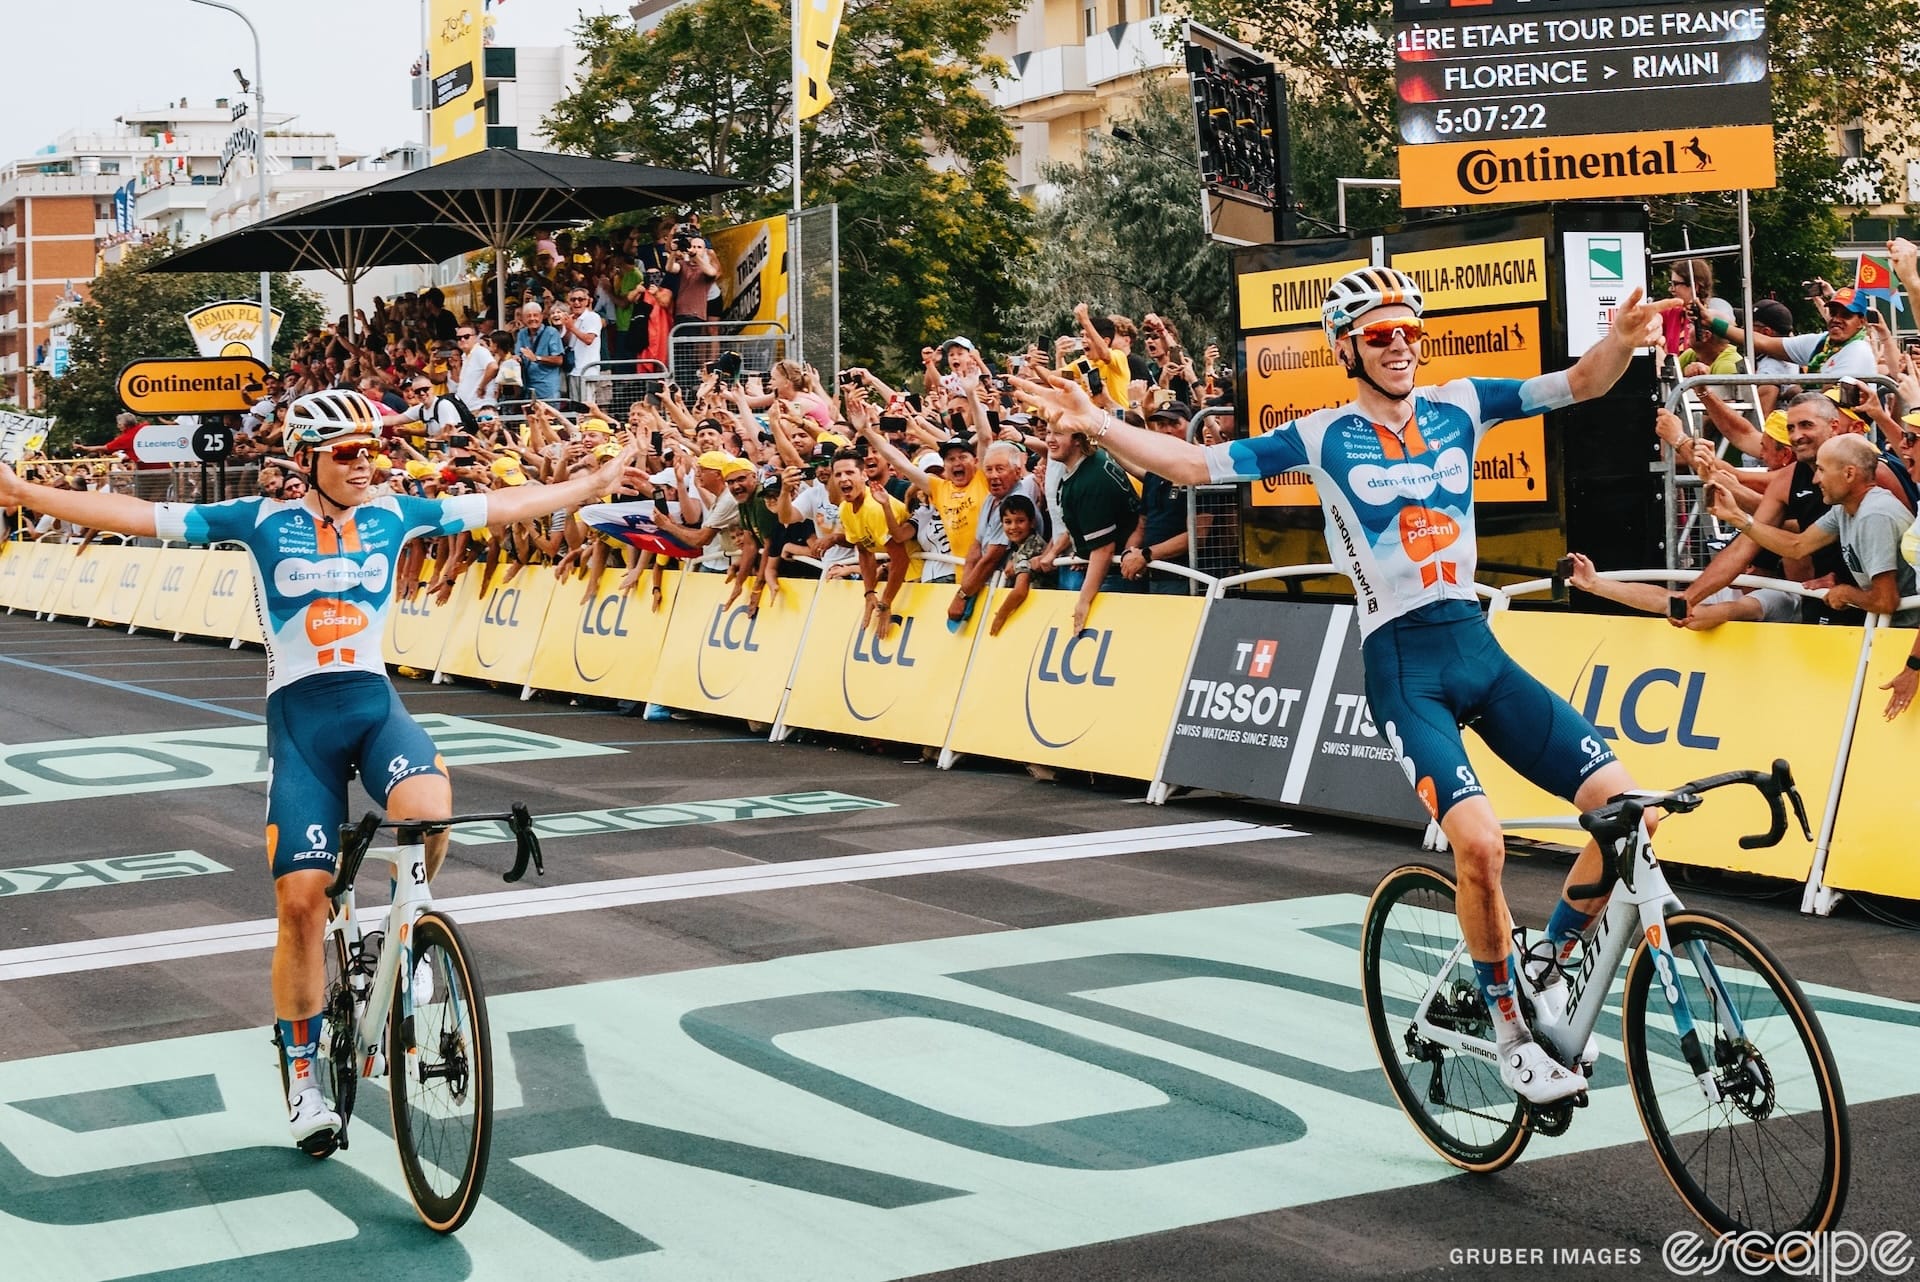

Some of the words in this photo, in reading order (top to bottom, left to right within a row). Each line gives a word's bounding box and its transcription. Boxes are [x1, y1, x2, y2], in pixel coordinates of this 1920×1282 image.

[1463, 22, 1539, 48] ETAPE
[1544, 17, 1615, 43] TOUR
[1621, 14, 1657, 38] DE
[1661, 7, 1766, 35] FRANCE
[1443, 59, 1588, 91] FLORENCE
[1632, 51, 1720, 79] RIMINI
[1434, 103, 1548, 134] 5:07:22
[1456, 140, 1677, 195] Continental
[1407, 258, 1538, 295] MILIA-ROMAGNA
[210, 322, 260, 341] Hotel
[128, 373, 241, 398] Continental
[203, 434, 225, 452] 25
[1346, 451, 1382, 460] zoover
[1367, 465, 1463, 489] dsm-firmenich
[1331, 504, 1357, 558] ANDERS
[1407, 522, 1454, 544] postnl
[120, 563, 140, 588] LCL
[162, 566, 185, 592] LCL
[212, 568, 239, 597] LCL
[289, 567, 383, 581] dsm-firmenich
[1352, 561, 1374, 597] HANS
[312, 615, 362, 630] postnl
[484, 586, 523, 628] LCL
[582, 592, 629, 638] LCL
[707, 602, 760, 652] LCL
[853, 614, 916, 667] LCL
[1038, 626, 1116, 687] LCL
[1186, 679, 1302, 728] TISSOT
[1333, 693, 1377, 738] TIS
[1583, 664, 1721, 750] LCL
[1176, 723, 1202, 738] SWISS
[1202, 725, 1243, 744] WATCHES
[1242, 732, 1269, 746] SINCE
[1268, 734, 1289, 749] 1853
[1321, 741, 1350, 757] SWISS
[1349, 742, 1395, 762] WATCHES
[1566, 906, 1610, 1026] SCOTT
[1461, 1041, 1498, 1061] SHIMANO
